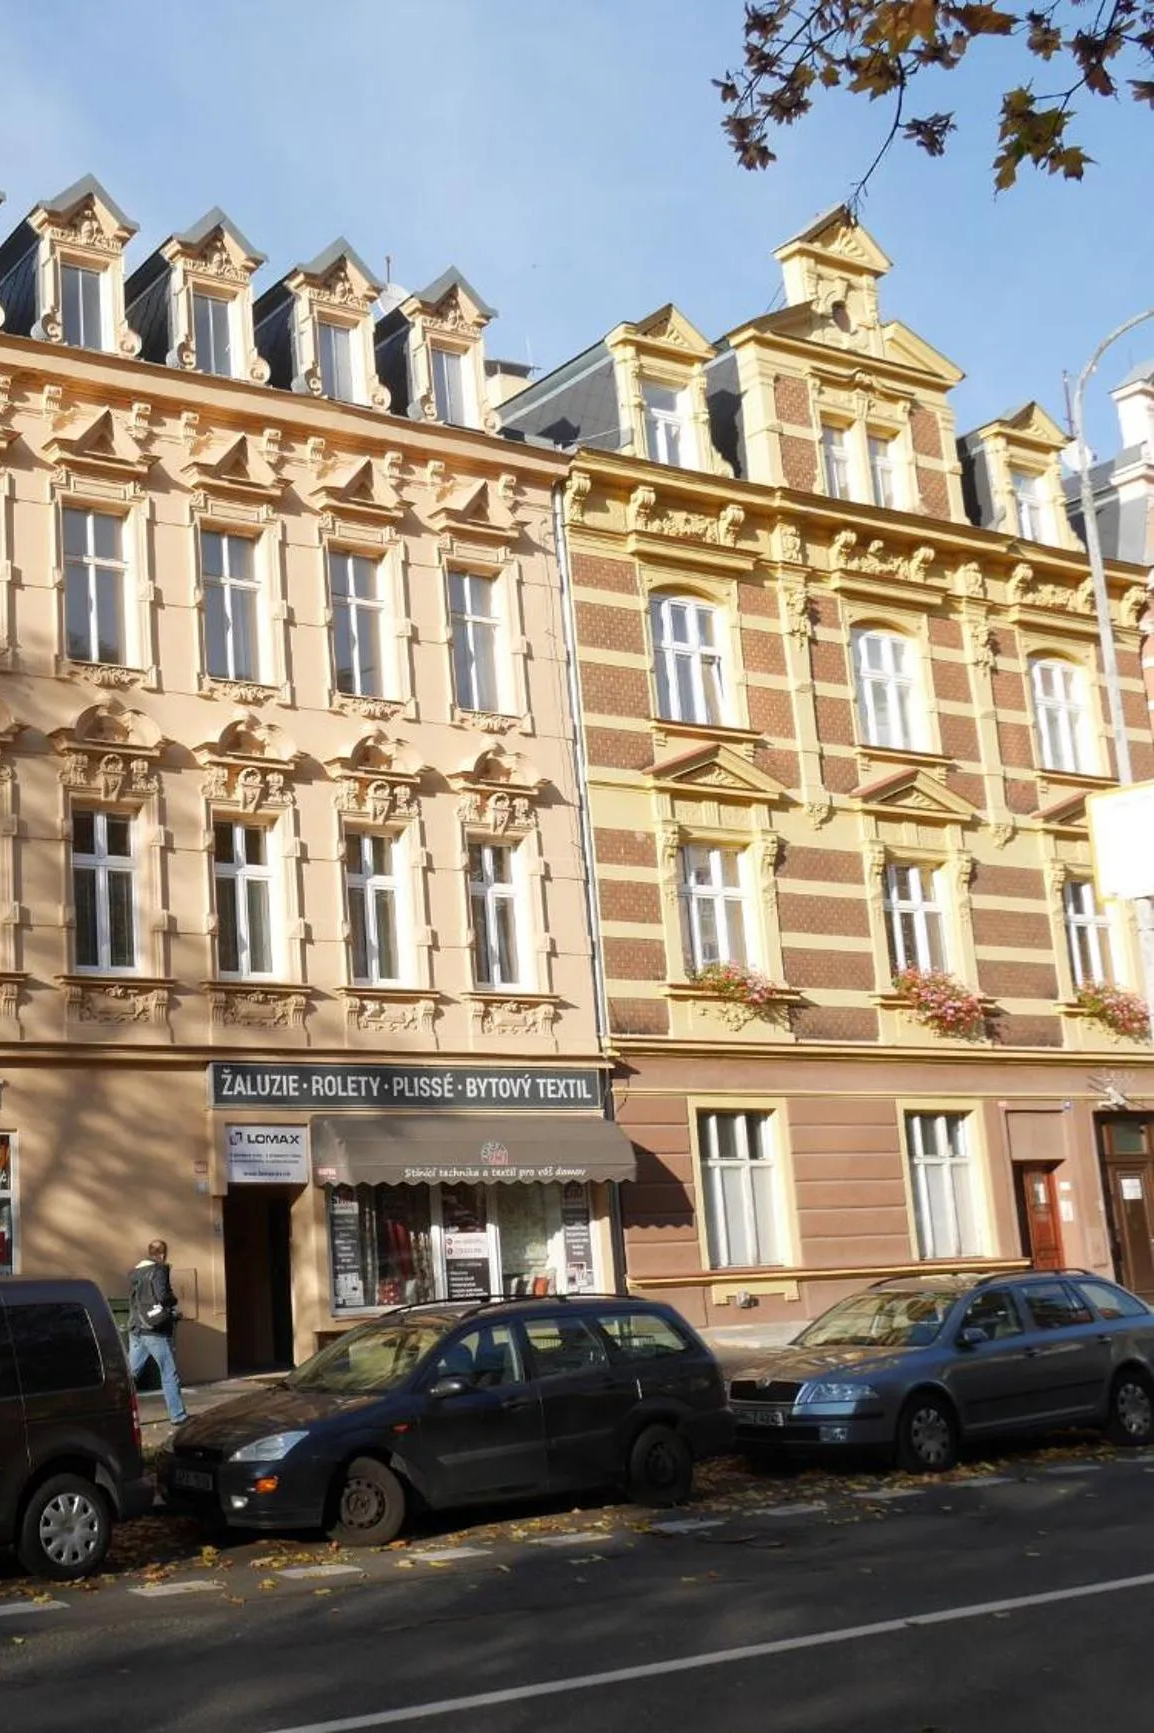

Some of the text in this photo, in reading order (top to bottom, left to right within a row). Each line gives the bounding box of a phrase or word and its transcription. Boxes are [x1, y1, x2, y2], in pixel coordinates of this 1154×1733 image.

[221, 1068, 592, 1099] ŽALUZIE ROLETY PLISSÉ BYTOVÝ TEXTIL
[247, 1134, 301, 1145] LOMAX
